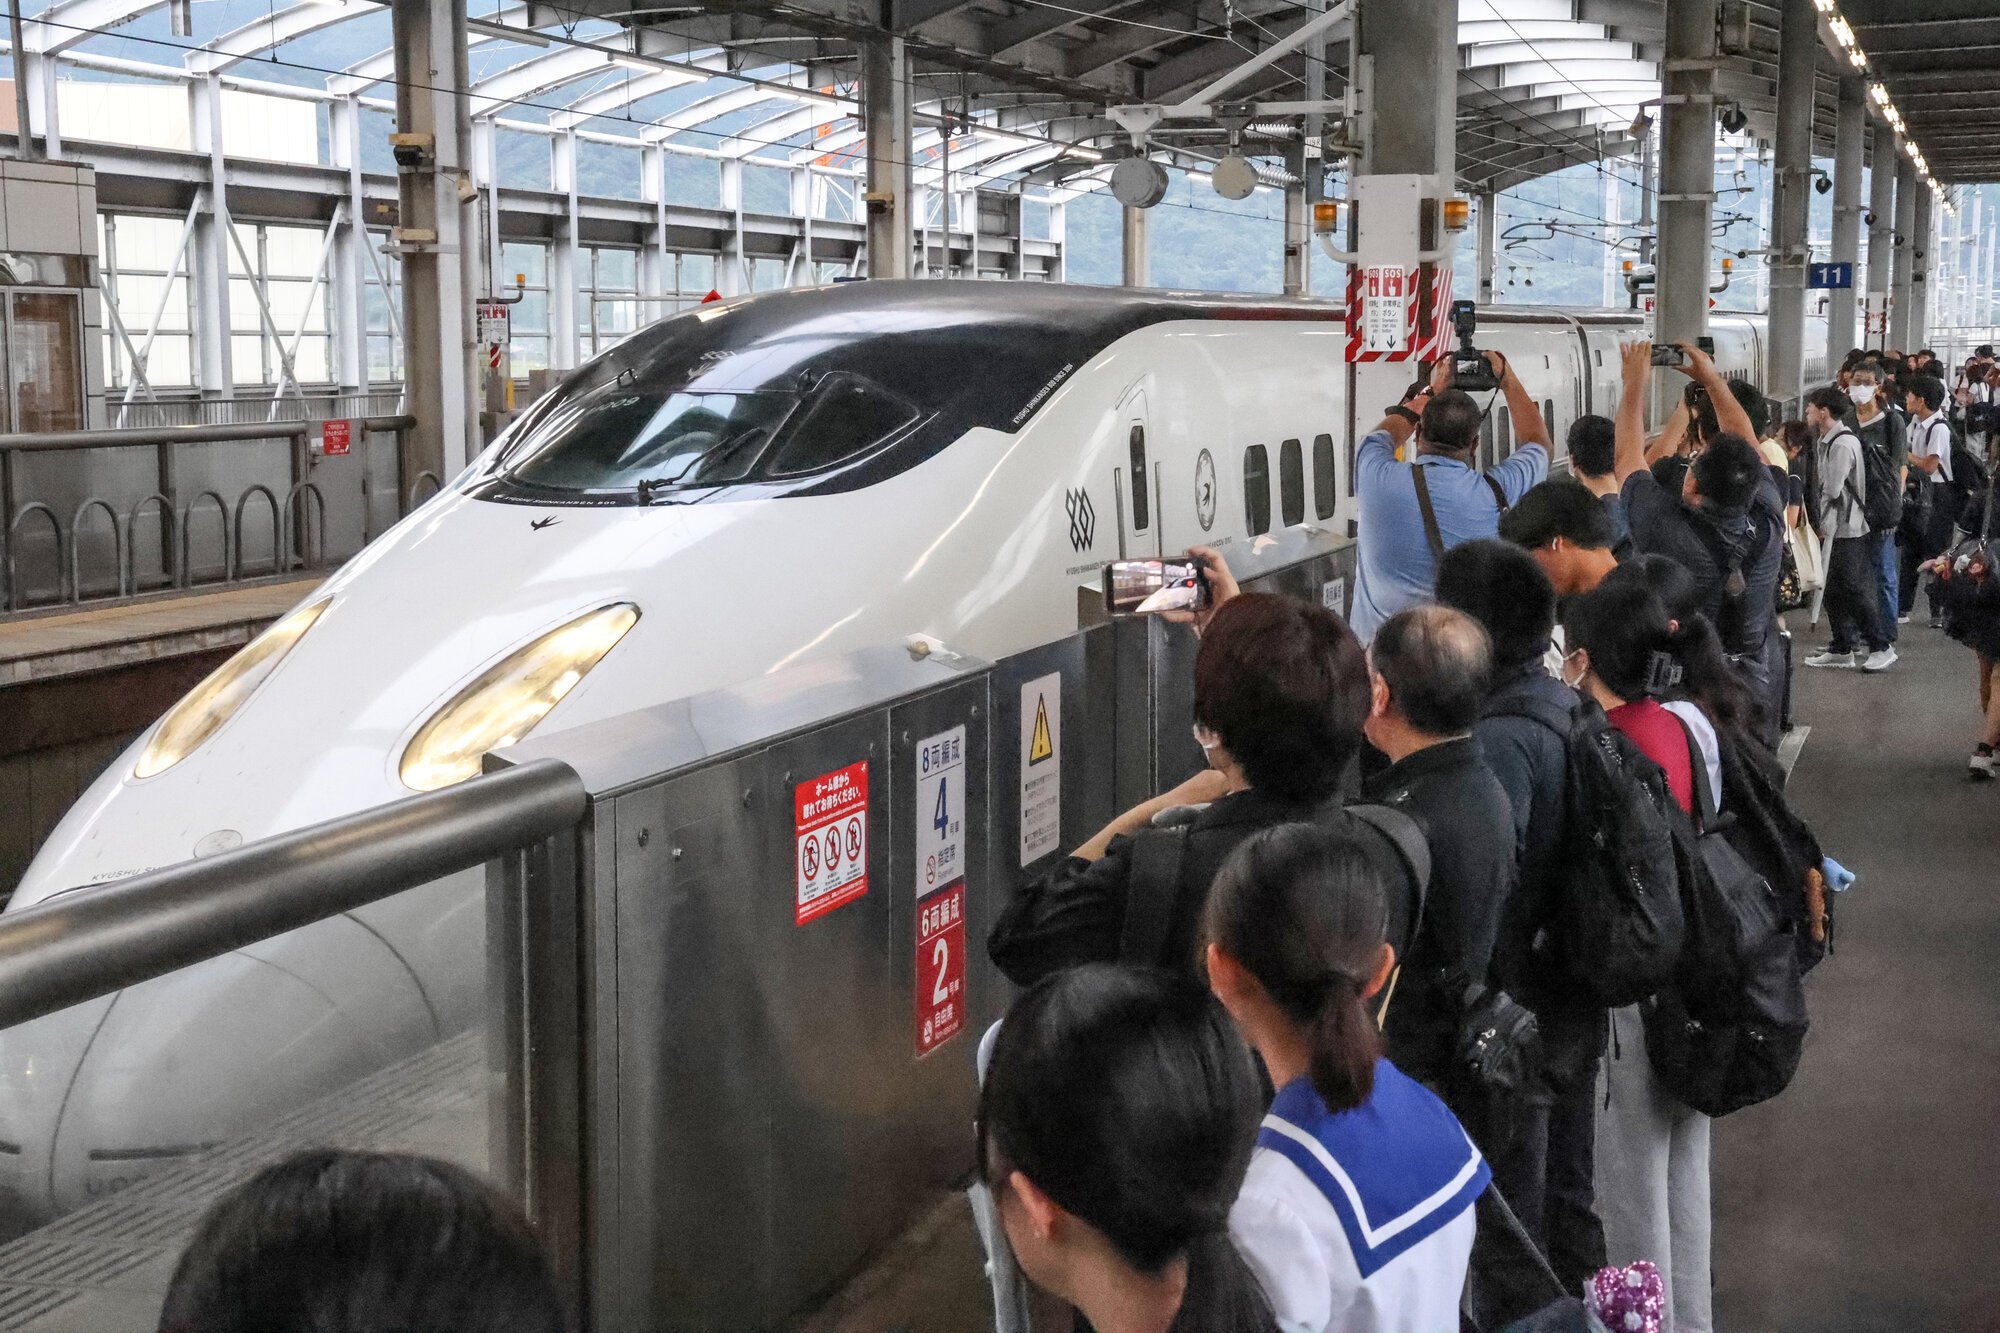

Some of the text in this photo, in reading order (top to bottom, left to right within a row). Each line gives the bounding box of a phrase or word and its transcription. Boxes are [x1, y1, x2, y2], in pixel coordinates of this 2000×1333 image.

[1369, 269, 1379, 278] SOS
[1384, 268, 1401, 278] SOS
[1819, 267, 1841, 284] 11
[922, 736, 960, 773] 8両編成
[934, 777, 948, 840] 4
[91, 868, 140, 881] KYUSHU
[922, 893, 960, 937] 6両編成
[933, 938, 948, 1006] 2
[934, 1003, 953, 1028] 自由席
